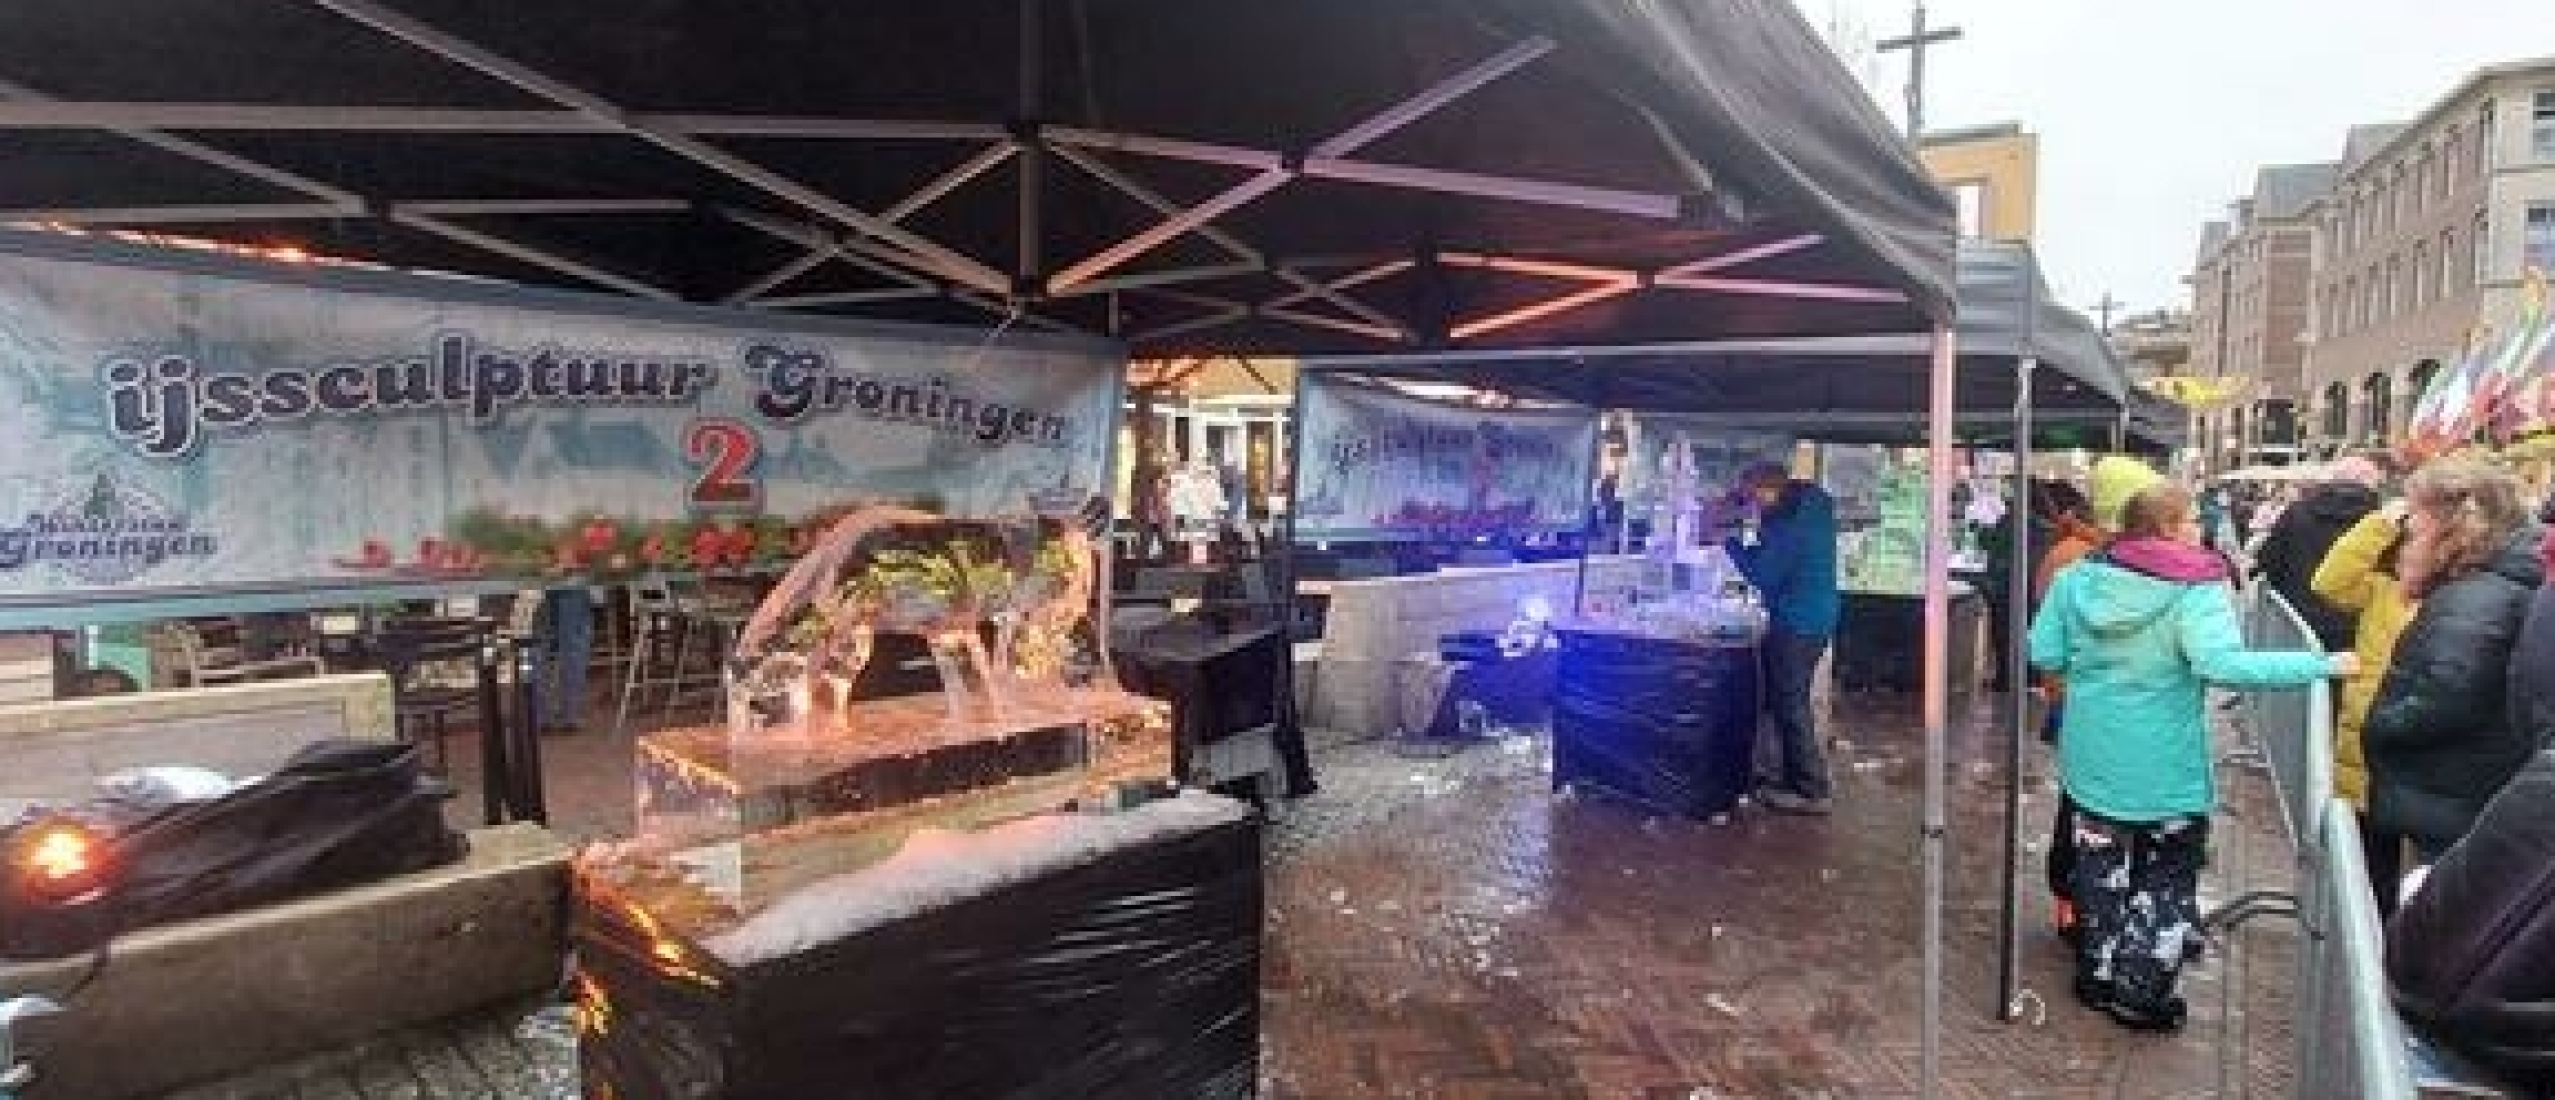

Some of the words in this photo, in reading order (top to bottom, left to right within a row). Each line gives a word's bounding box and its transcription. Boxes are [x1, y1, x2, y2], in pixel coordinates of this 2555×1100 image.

[108, 334, 711, 456] ijssculptuur
[743, 343, 1066, 446] Groningen
[684, 418, 760, 505] 2
